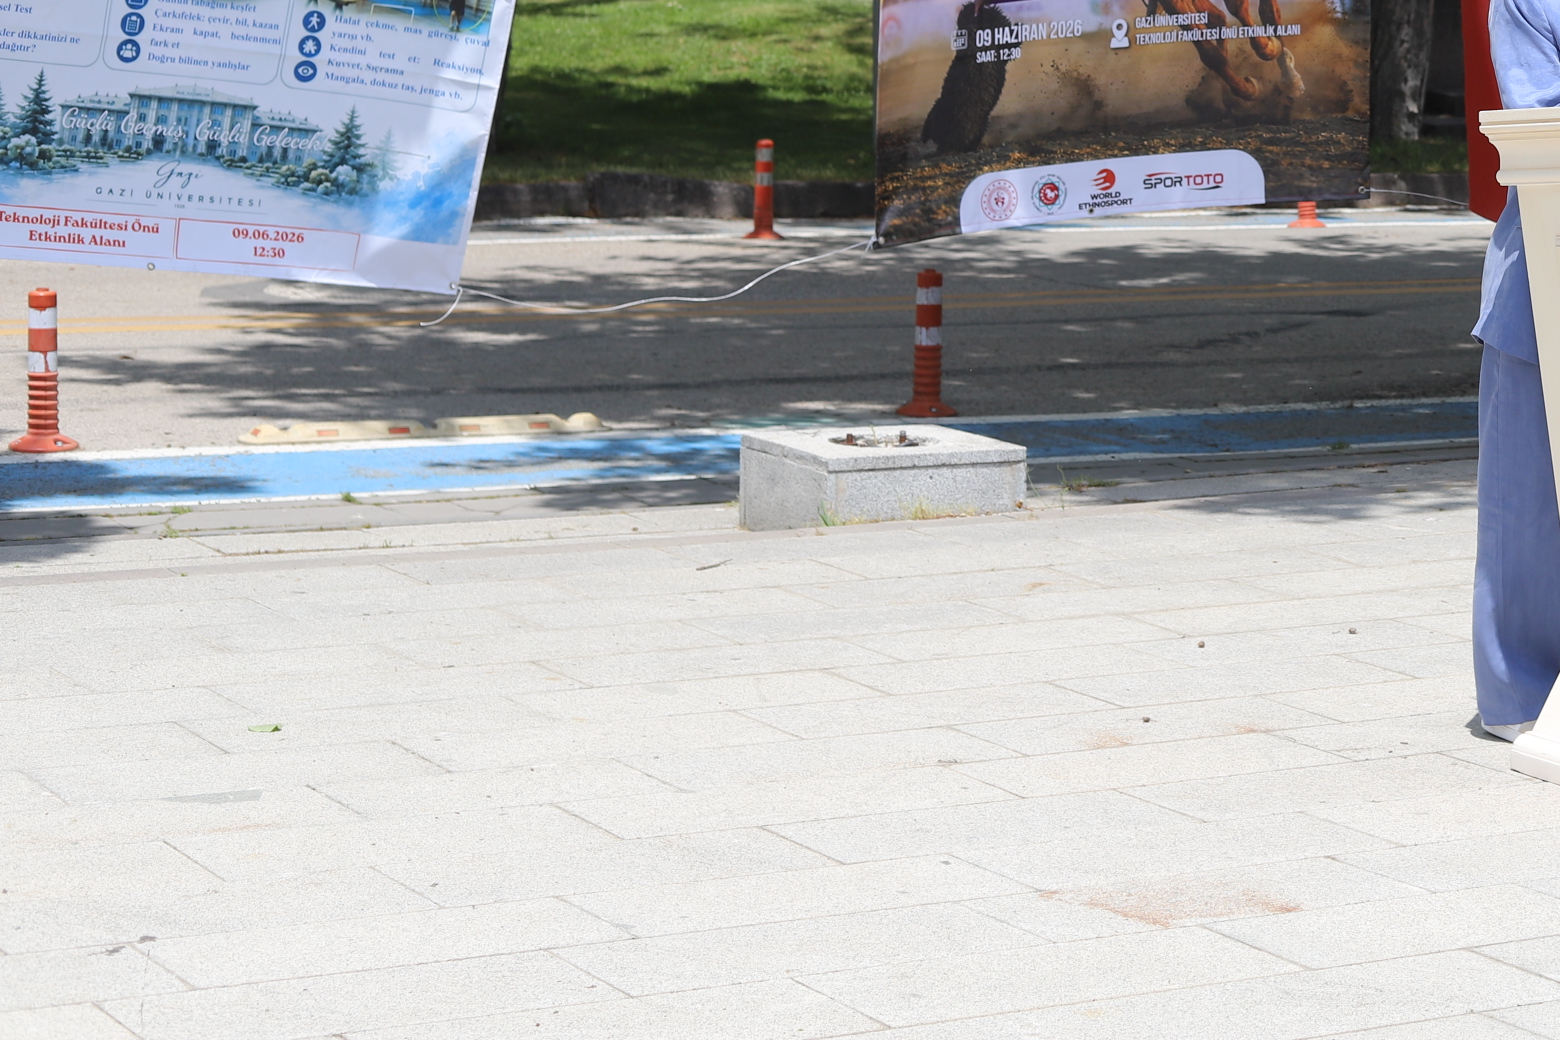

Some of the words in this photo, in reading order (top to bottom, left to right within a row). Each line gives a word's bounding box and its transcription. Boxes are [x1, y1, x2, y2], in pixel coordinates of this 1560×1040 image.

[14, 4, 32, 14] Test
[230, 3, 256, 14] keşfet
[152, 22, 184, 34] Ekranı
[252, 21, 280, 30] kazan
[1136, 16, 1154, 28] GAZİ
[1154, 11, 1209, 27] ÜNİVERSİTESİ
[18, 30, 68, 43] dikkatinizi
[70, 36, 80, 44] ne
[331, 30, 358, 42] yarışı
[360, 33, 374, 43] vb.
[334, 14, 361, 27] Halat
[404, 26, 422, 36] mas
[464, 35, 491, 48] çuval
[975, 30, 992, 48] 09
[994, 24, 1048, 46] HAZİRAN
[1050, 20, 1083, 38] 2026
[1135, 28, 1178, 46] TEKNOLOJİ
[1179, 26, 1220, 42] FAKÜLTESİ
[1220, 26, 1238, 40] ÖNÜ
[1239, 24, 1275, 38] ETKİNLİK
[1276, 23, 1300, 36] ALANI
[150, 38, 169, 48] fark
[171, 41, 180, 50] et
[330, 43, 367, 57] Kendini
[378, 50, 396, 60] test
[147, 52, 176, 64] Doğru
[178, 56, 208, 67] bilinen
[210, 60, 251, 72] yanlışlar
[976, 48, 998, 63] SAAT:
[998, 46, 1022, 60] 12:30
[366, 63, 404, 76] Sıçrama
[370, 78, 398, 90] dokuz
[419, 86, 446, 99] jenga
[448, 90, 463, 101] vb.
[62, 106, 115, 135] Güçlü
[196, 118, 248, 146] Güçlü
[95, 186, 134, 199] GAZİ
[145, 188, 264, 208] ÜNİVERSİTESİ
[1078, 198, 1134, 210] ETHNOSPORT
[1090, 190, 1121, 201] WORLD
[0, 210, 61, 229] Teknoloji
[64, 214, 128, 232] Fakültesi
[132, 218, 160, 234] Önü
[28, 230, 86, 246] Etkinlik
[89, 234, 127, 248] Alanı
[232, 227, 305, 244] 09.06.2026
[253, 246, 286, 260] 12:30
